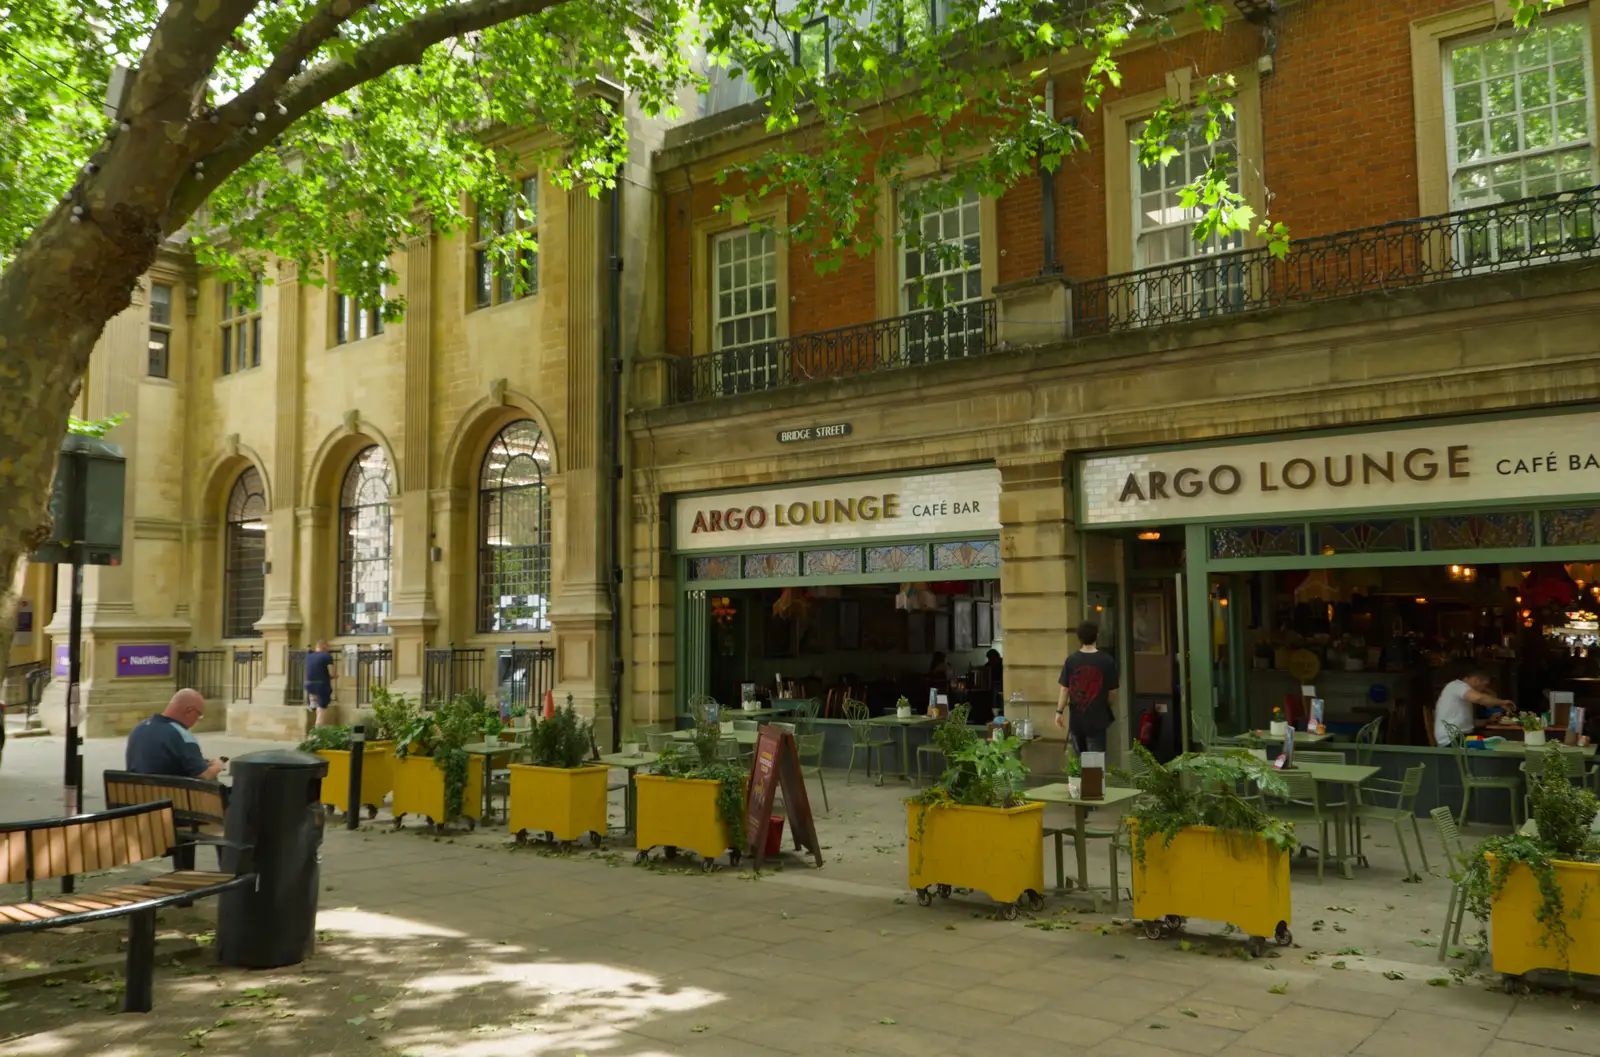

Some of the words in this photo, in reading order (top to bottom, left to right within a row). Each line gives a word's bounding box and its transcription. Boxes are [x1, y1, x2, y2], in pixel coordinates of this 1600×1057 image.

[781, 429, 811, 442] BRIDGE
[816, 424, 846, 438] STREET
[1118, 464, 1242, 502] ARGO
[1260, 444, 1471, 491] LOUNGE
[1496, 451, 1558, 475] CAFÉ
[691, 505, 766, 534] ARGO
[774, 493, 901, 527] LOUNGE
[912, 500, 948, 517] CAFÉ
[953, 501, 980, 515] BAR
[130, 655, 169, 666] NatWest
